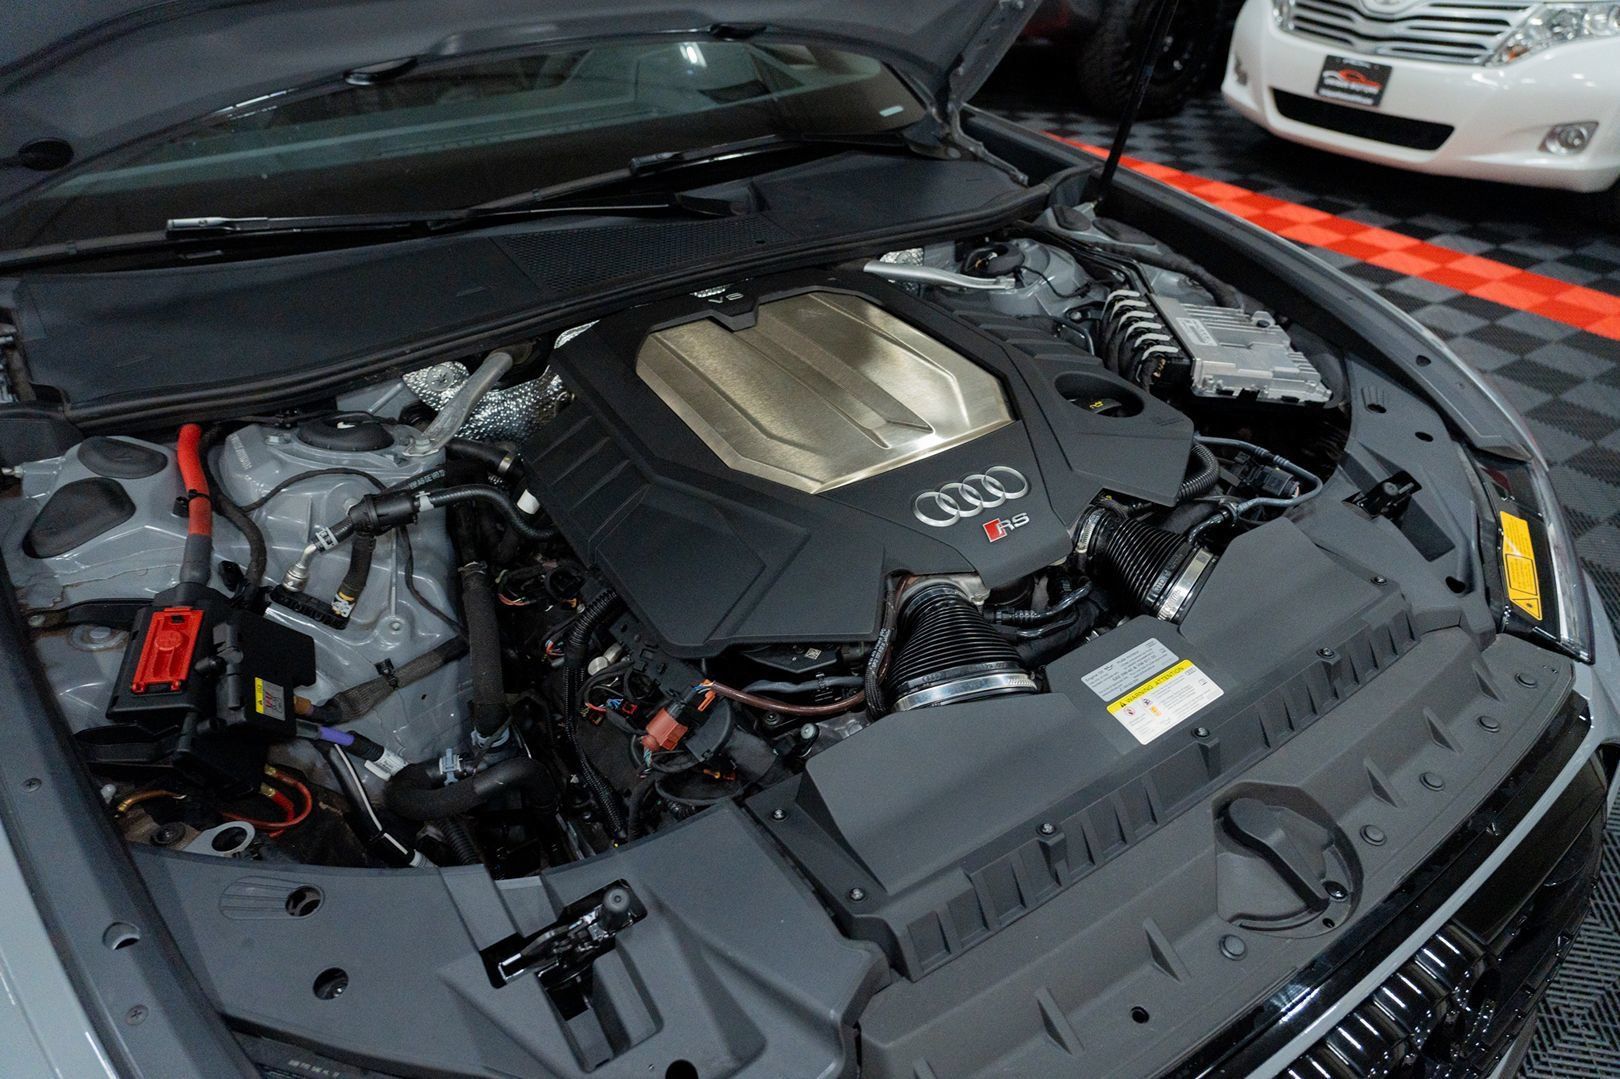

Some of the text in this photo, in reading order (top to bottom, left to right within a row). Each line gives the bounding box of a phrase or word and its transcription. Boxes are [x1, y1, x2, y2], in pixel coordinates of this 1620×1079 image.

[708, 292, 744, 304] V8
[994, 512, 1030, 537] RS
[1126, 684, 1154, 703] WARNING
[1155, 667, 1184, 686] ATTENTION
